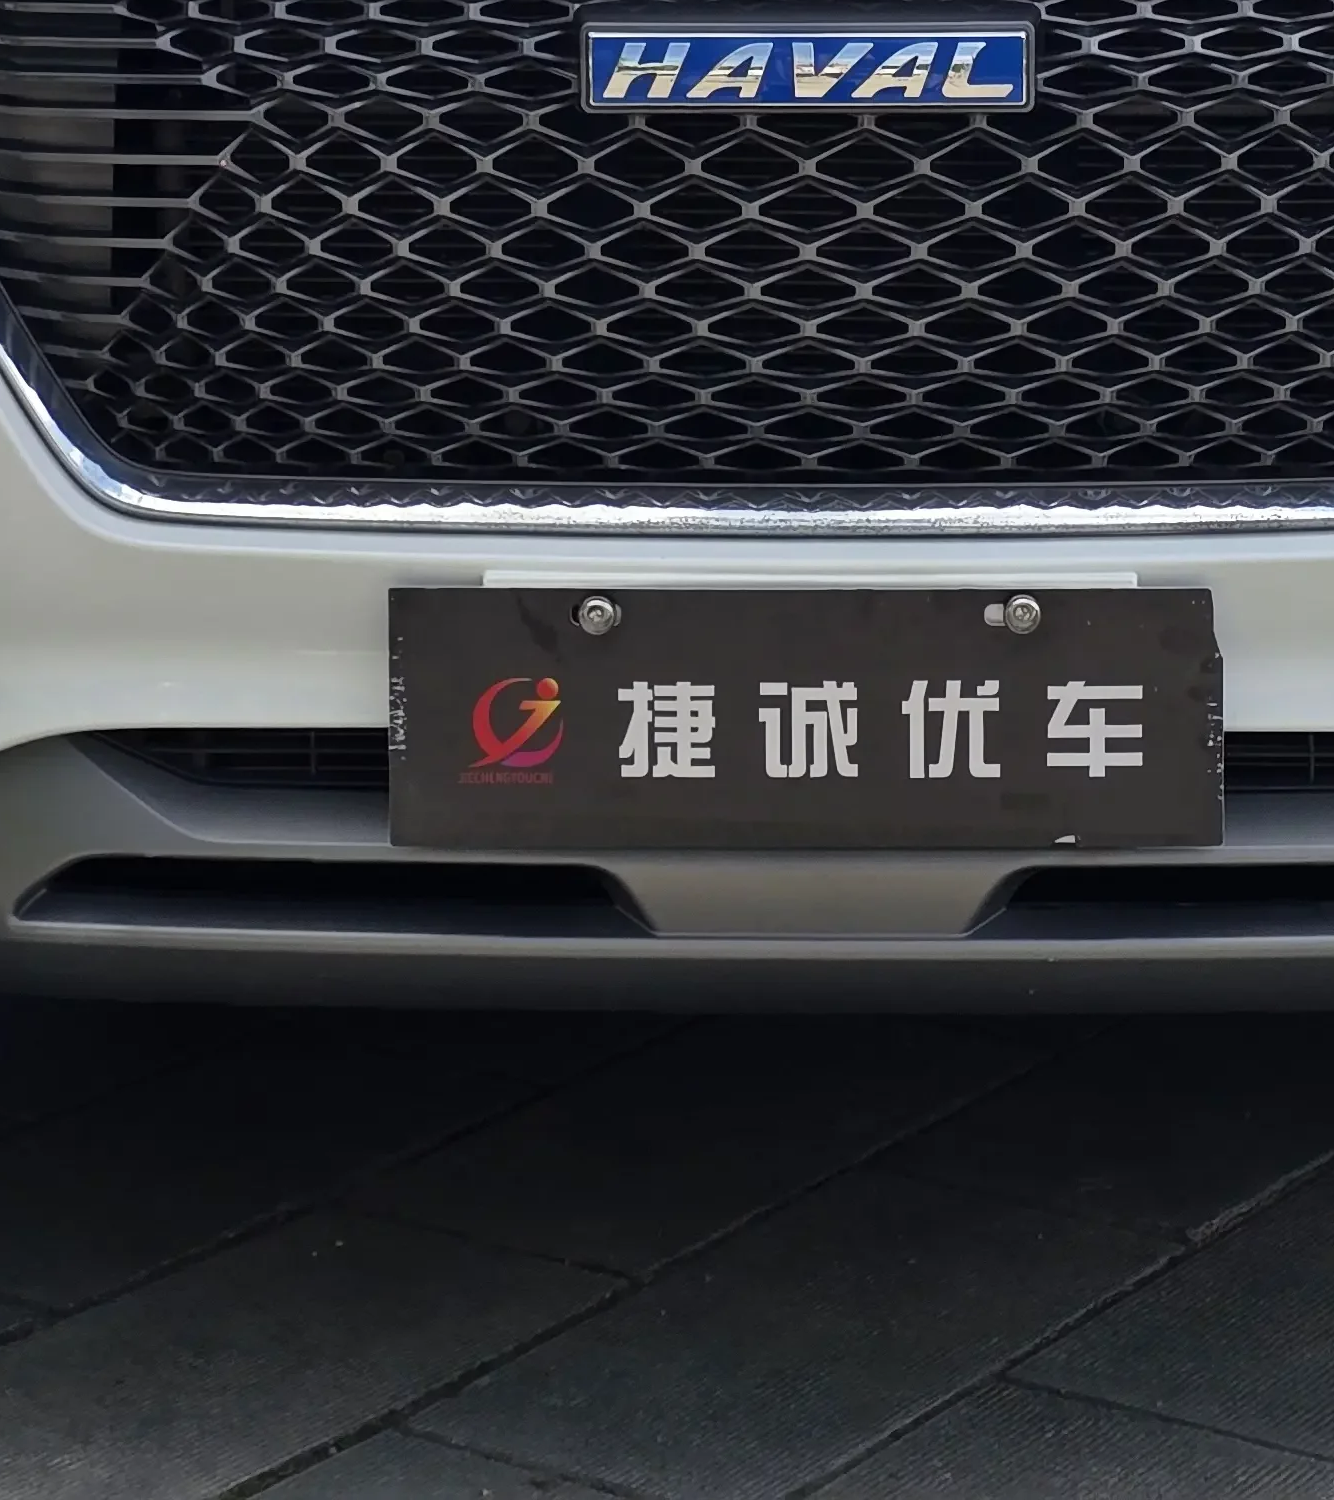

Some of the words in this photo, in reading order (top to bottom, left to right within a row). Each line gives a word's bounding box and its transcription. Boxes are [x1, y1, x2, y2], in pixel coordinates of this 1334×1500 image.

[603, 41, 1014, 99] HAVAL
[617, 680, 1145, 779] 捷诚优车
